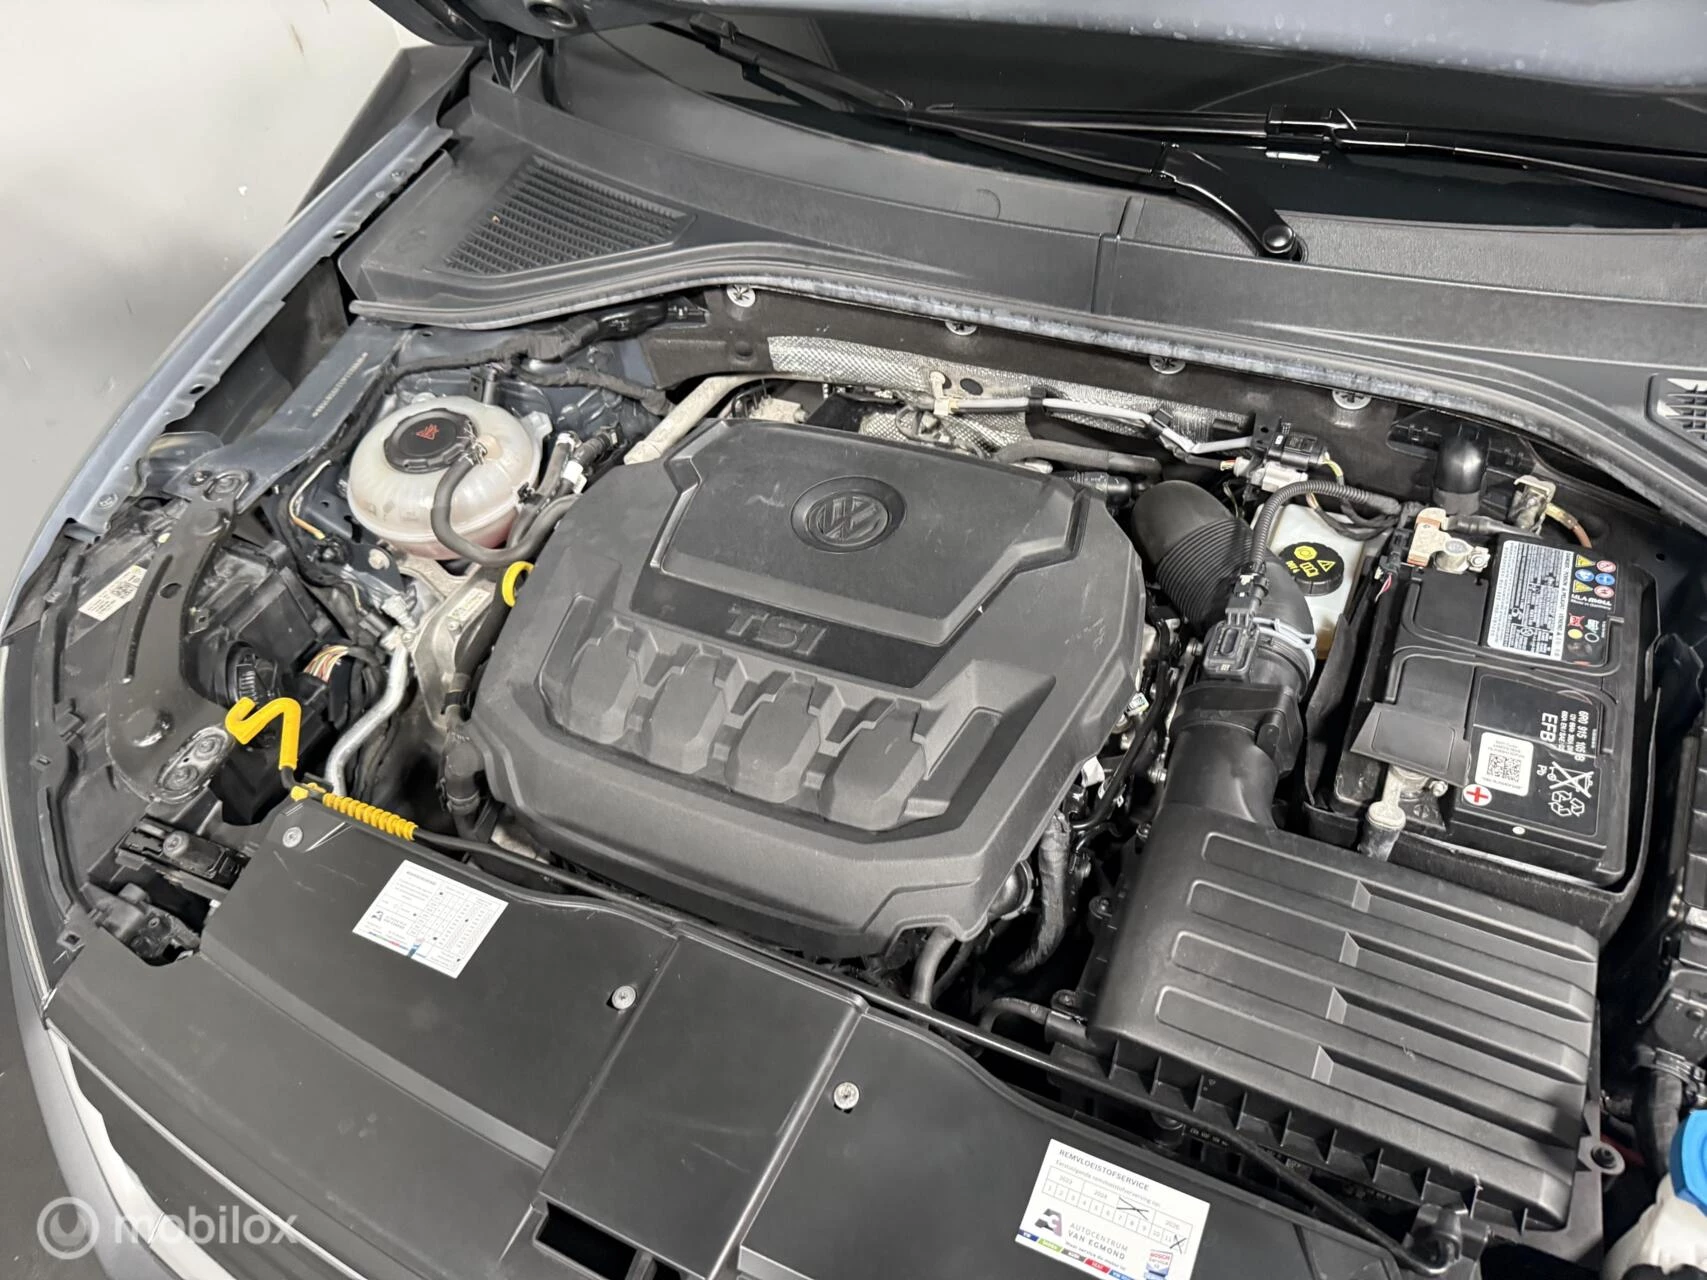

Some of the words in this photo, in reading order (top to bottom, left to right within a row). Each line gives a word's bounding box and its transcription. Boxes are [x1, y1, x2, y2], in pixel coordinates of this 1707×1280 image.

[726, 603, 829, 656] TSI
[1540, 712, 1558, 743] EFB
[1576, 726, 1588, 739] 915
[1059, 1149, 1149, 1191] REMVLOEISTOFSERVICE
[1068, 1230, 1085, 1242] VAN
[1088, 1237, 1125, 1260] EGMOND
[1070, 1223, 1128, 1251] AUTOCENTRUM
